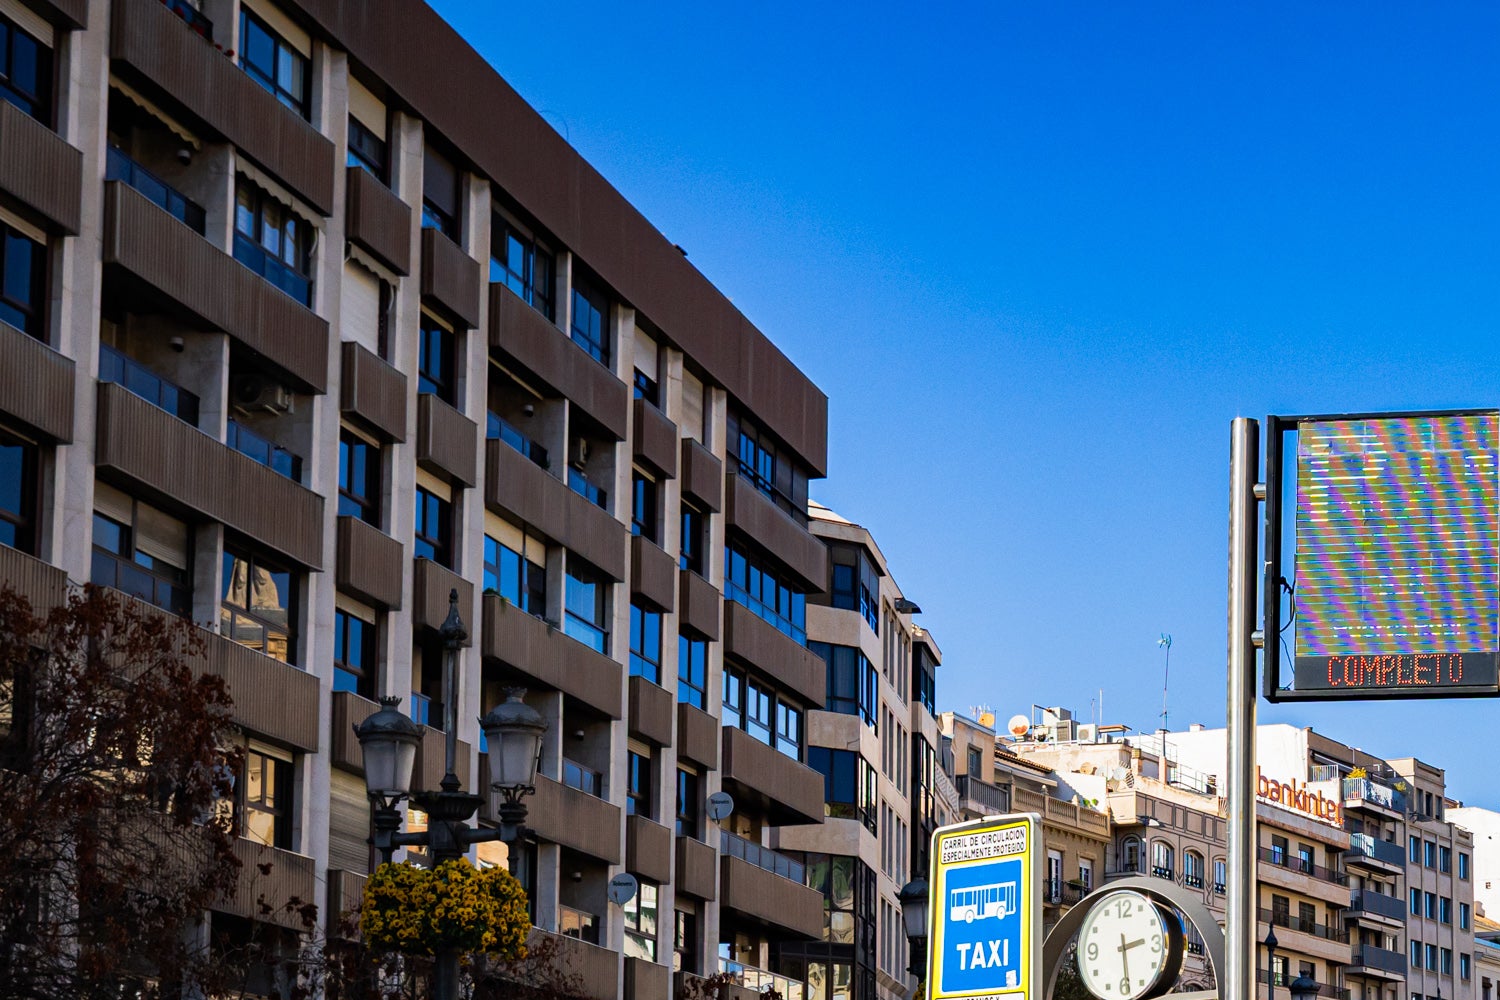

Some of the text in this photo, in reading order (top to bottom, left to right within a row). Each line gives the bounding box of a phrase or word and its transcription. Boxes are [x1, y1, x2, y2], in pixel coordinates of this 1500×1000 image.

[1327, 653, 1463, 687] COMPLETO
[1256, 765, 1344, 825] bankinter
[943, 842, 1024, 862] ESPECIALMENTE PROTEGIDO
[944, 838, 967, 850] CARRIL
[970, 836, 979, 846] DE
[1115, 899, 1132, 919] 12
[1087, 942, 1099, 961] 9
[1150, 934, 1161, 953] 3
[956, 938, 1009, 971] TAXI
